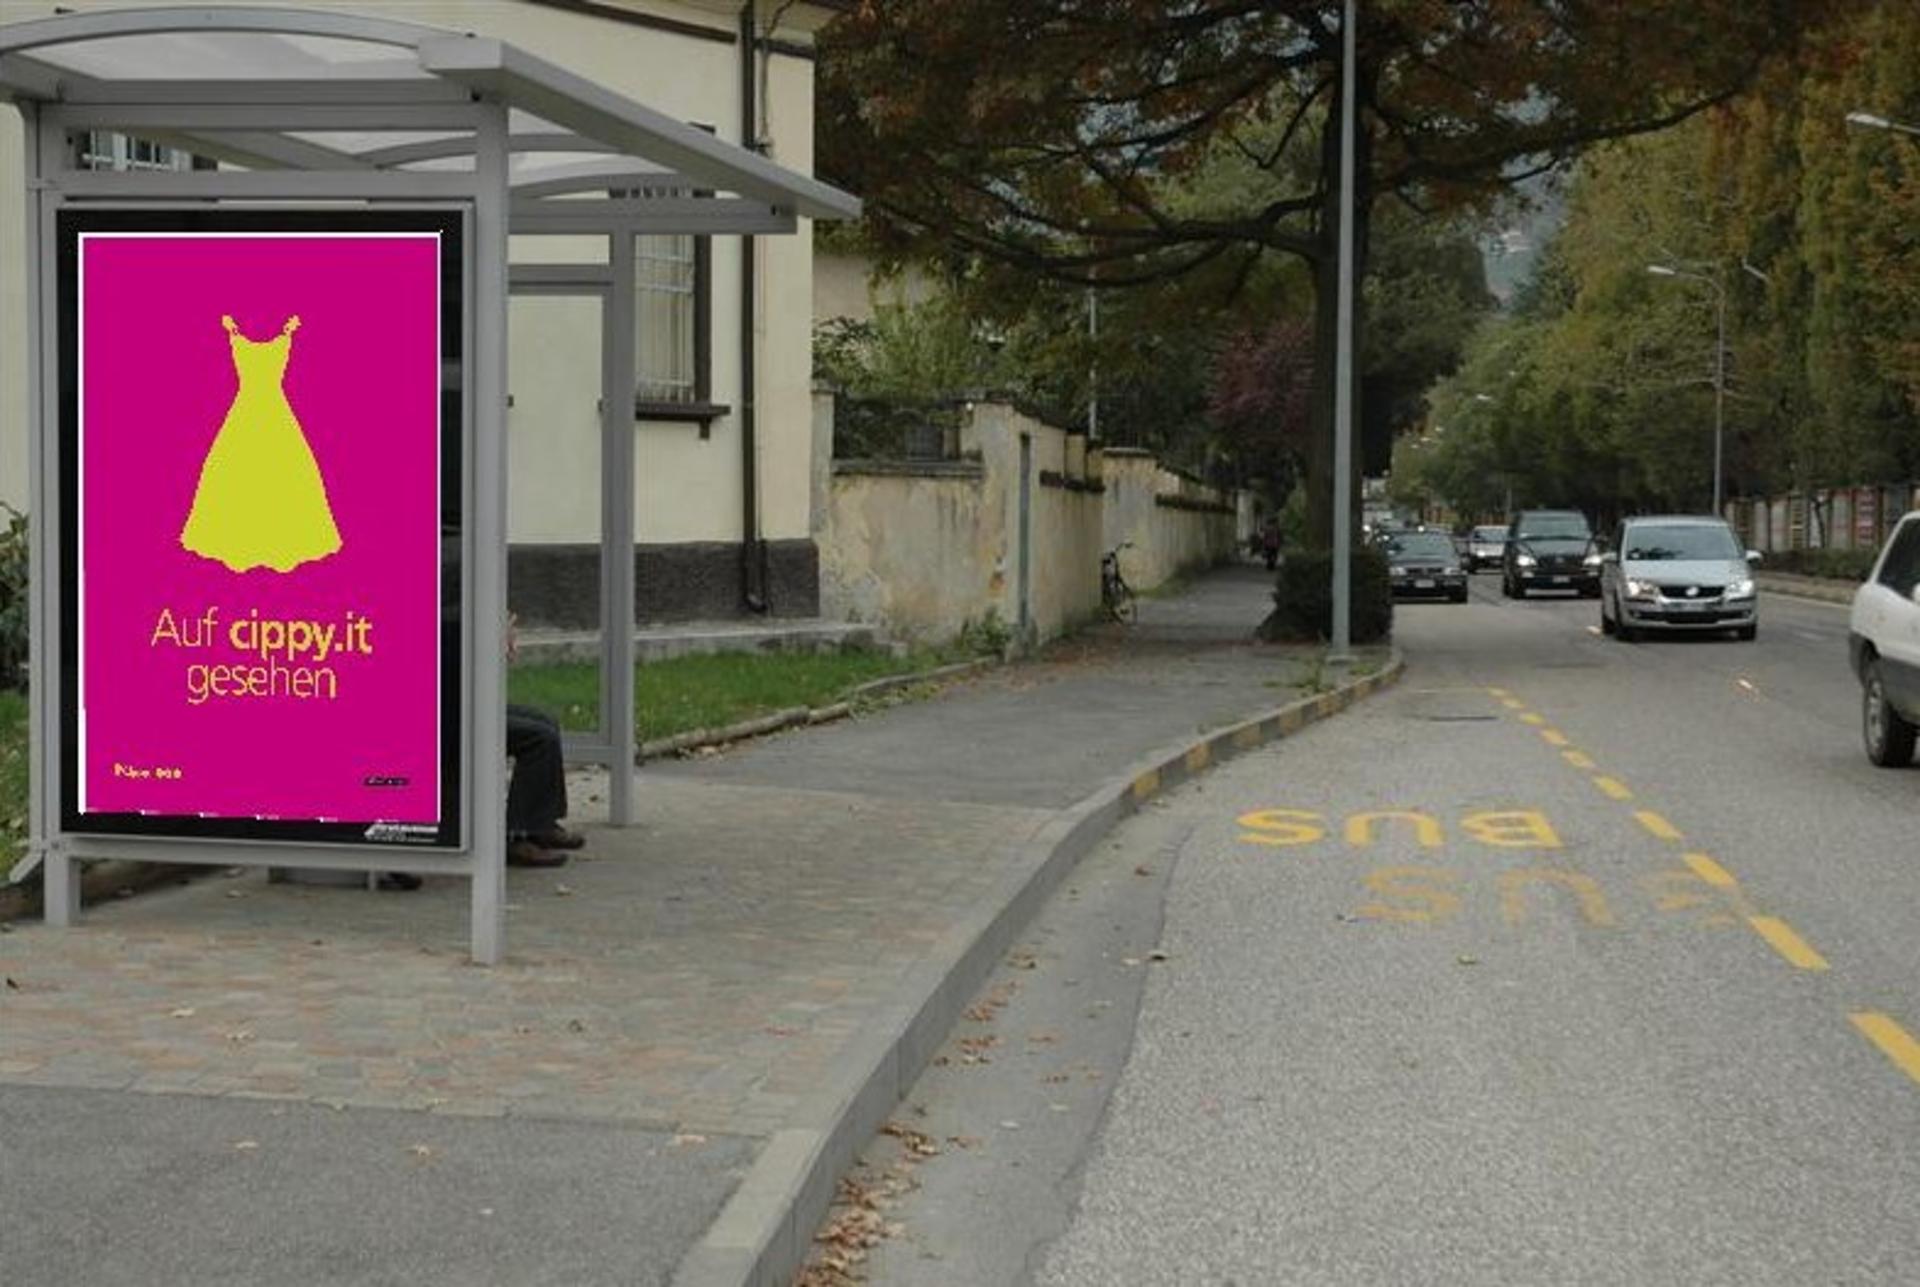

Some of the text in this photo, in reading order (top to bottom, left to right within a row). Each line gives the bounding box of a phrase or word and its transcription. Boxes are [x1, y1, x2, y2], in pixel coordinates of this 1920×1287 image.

[151, 606, 373, 662] Auf cippy.it
[187, 655, 337, 704] gesehen
[1236, 808, 1565, 848] BUS
